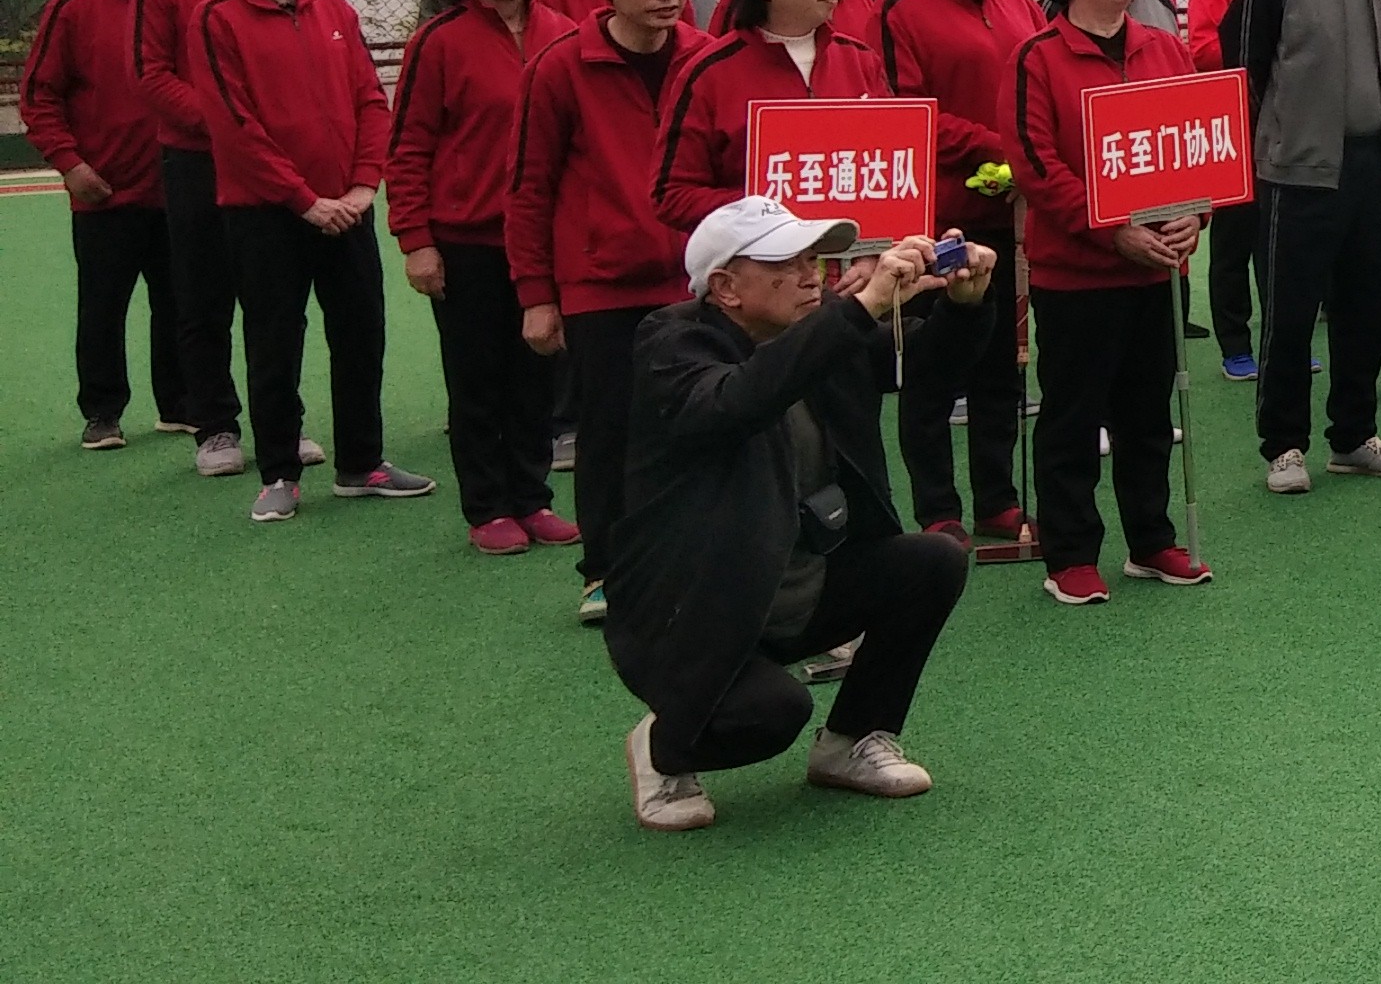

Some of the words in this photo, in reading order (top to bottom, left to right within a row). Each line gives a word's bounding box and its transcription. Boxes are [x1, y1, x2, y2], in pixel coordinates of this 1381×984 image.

[765, 147, 920, 202] 乐至通达队
[1101, 114, 1238, 180] 乐至门协队
